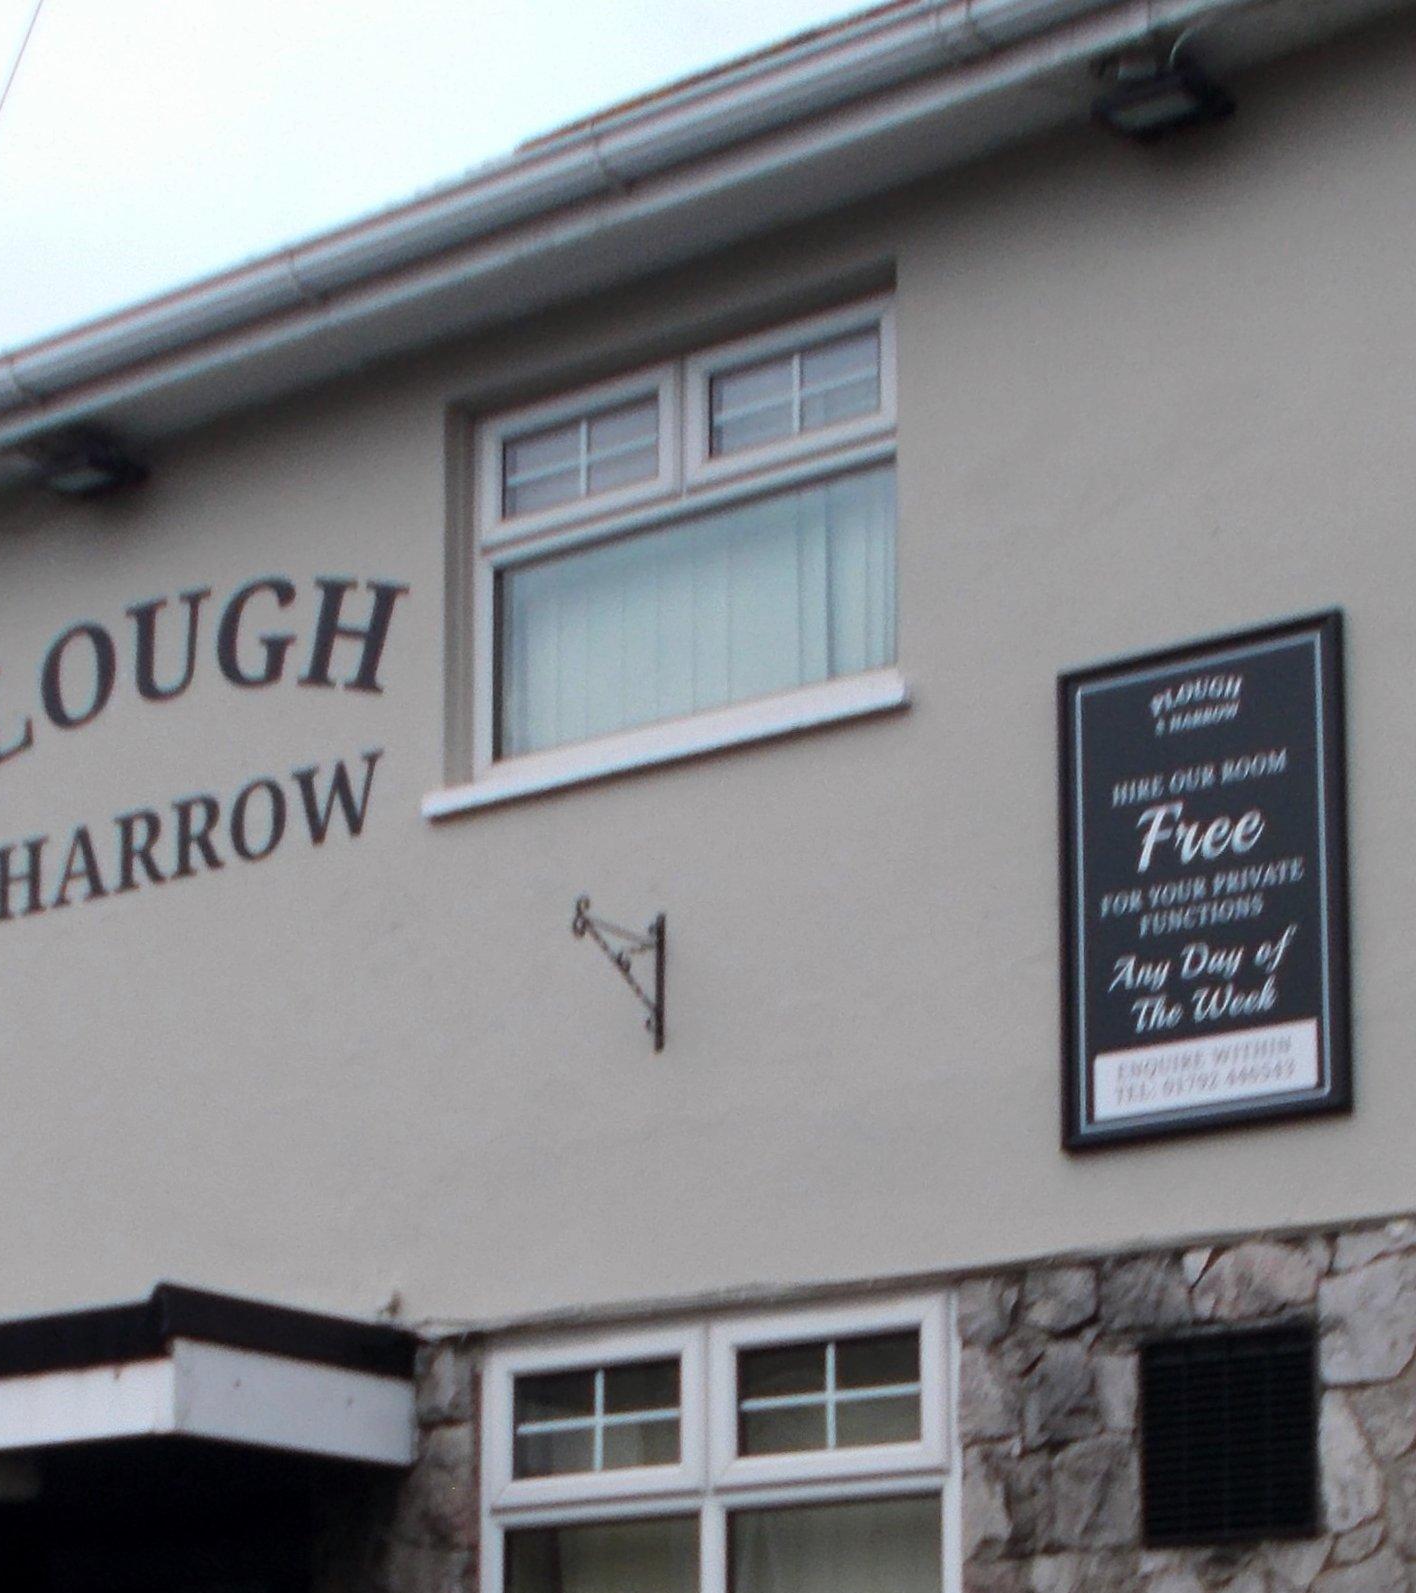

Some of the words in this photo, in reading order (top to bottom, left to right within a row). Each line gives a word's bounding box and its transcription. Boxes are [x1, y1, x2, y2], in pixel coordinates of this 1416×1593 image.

[1150, 674, 1243, 717] PLOUGH
[1112, 773, 1164, 808] HIRE
[1169, 763, 1215, 791] OUR
[1221, 747, 1287, 785] ROOM
[1136, 800, 1266, 873] Free
[1100, 889, 1143, 919] FOR
[1148, 875, 1206, 908] YOUR
[1212, 856, 1305, 897] PRIVATE
[1139, 892, 1264, 938] FUNCTIONS
[1107, 955, 1171, 992] Any
[1181, 942, 1244, 980] Day
[1255, 923, 1298, 974] of
[1131, 993, 1184, 1034] The
[1192, 974, 1277, 1023] Week
[1117, 1051, 1203, 1081] ENQUIRE
[1213, 1036, 1292, 1066] WITHIN
